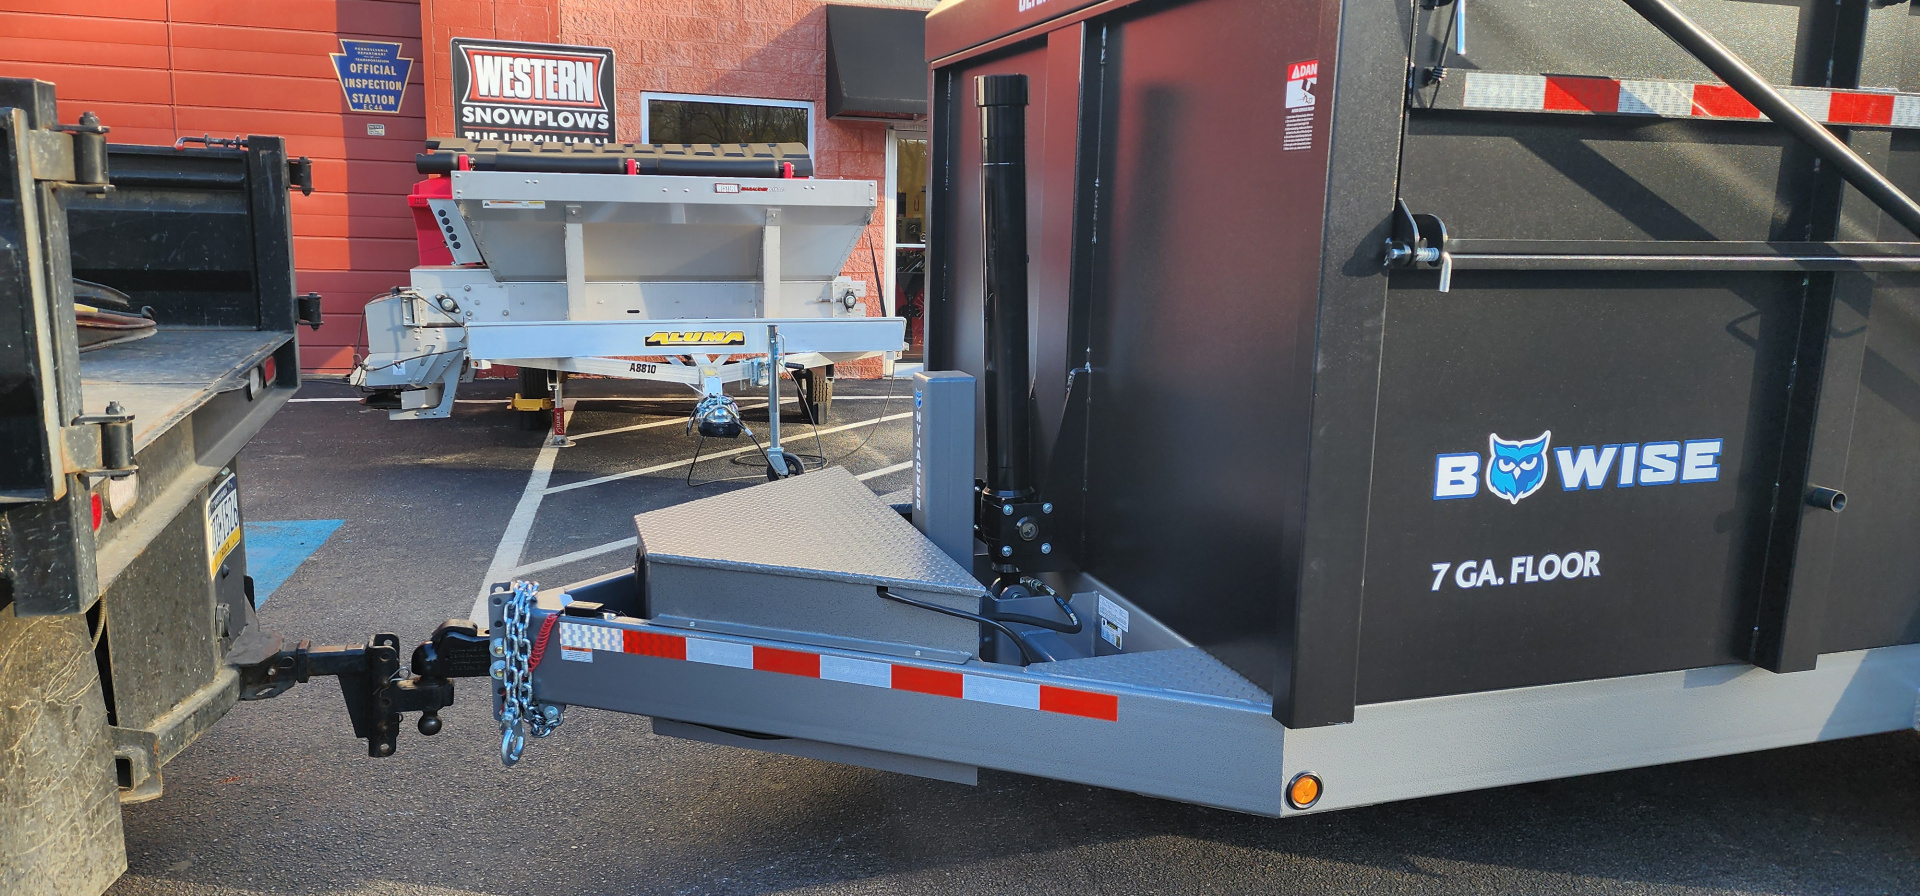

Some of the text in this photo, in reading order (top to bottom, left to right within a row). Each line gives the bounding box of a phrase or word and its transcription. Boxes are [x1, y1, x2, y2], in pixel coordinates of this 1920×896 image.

[350, 62, 398, 76] OFFICIAL
[344, 78, 402, 91] INSPECTION
[473, 54, 594, 102] WESTERN
[352, 93, 396, 105] STATION
[462, 106, 610, 130] SNOWPLOWS
[646, 331, 744, 345] ALUMA
[629, 362, 657, 375] A8810
[1431, 550, 1601, 592] 7 GA. FLOOR
